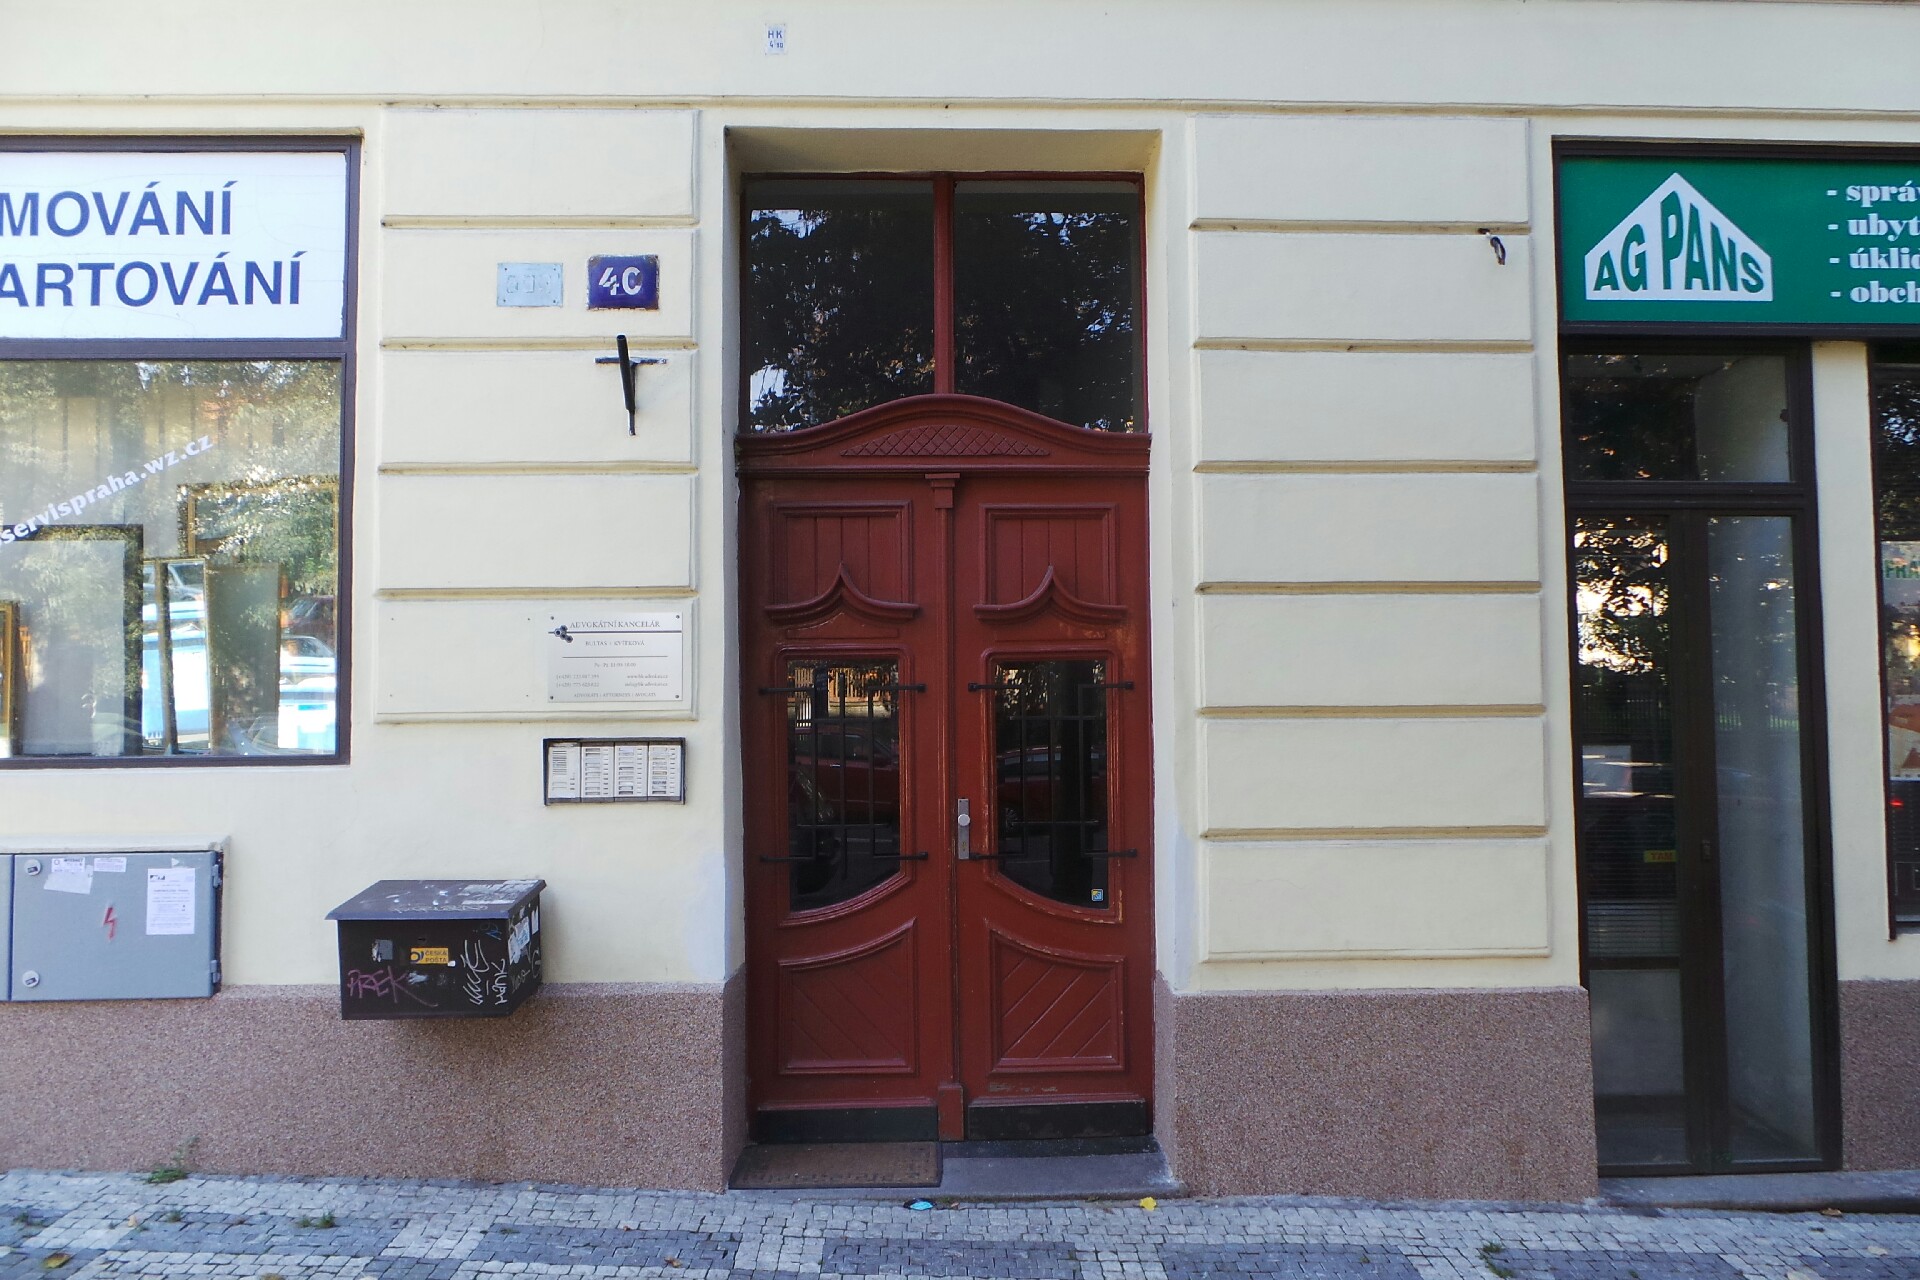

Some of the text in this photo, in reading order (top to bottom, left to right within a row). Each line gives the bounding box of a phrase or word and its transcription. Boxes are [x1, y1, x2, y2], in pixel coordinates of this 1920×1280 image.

[0, 180, 239, 238] MOVÁNÍ
[1593, 190, 1765, 294] AG PANS
[0, 250, 308, 308] ARTOVÁNÍ
